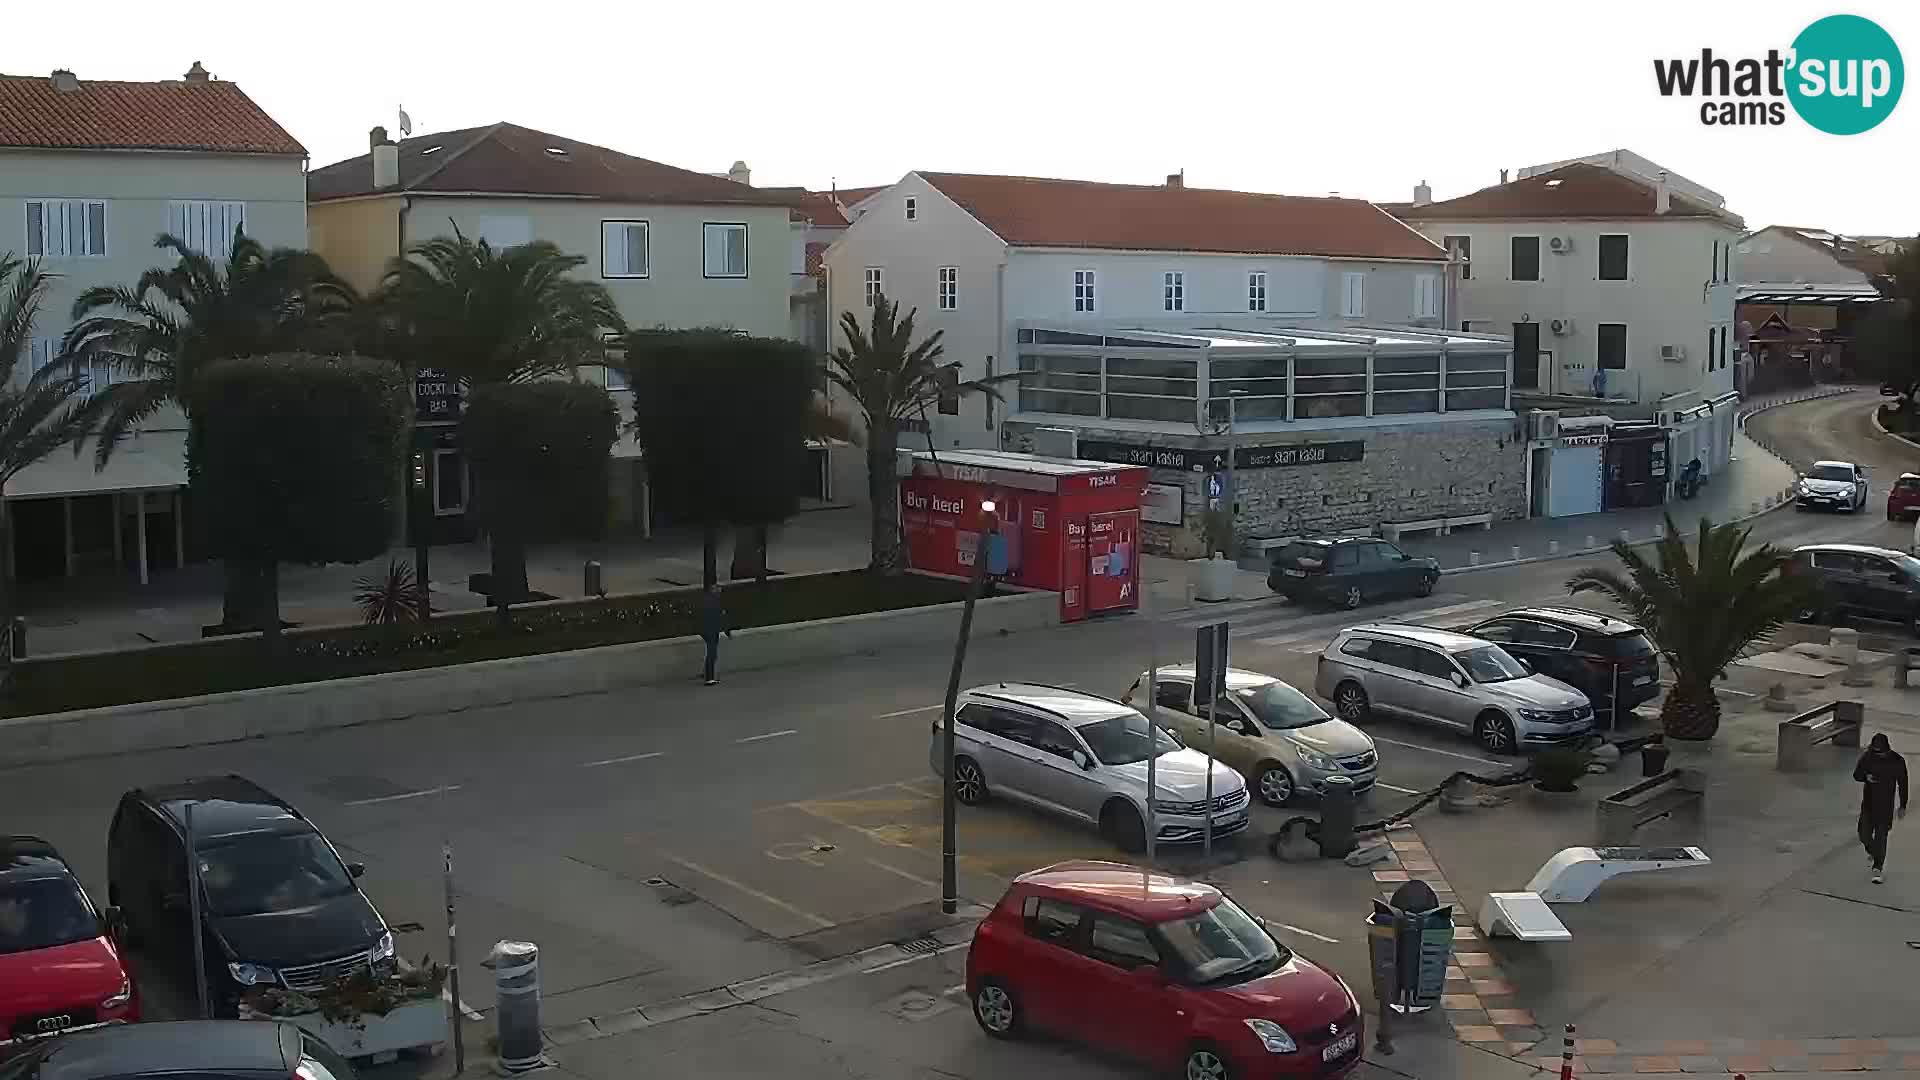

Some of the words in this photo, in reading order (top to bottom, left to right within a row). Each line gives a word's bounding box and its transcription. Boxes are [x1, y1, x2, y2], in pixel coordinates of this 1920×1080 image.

[418, 383, 460, 396] COCKTL
[1088, 475, 1117, 488] TISAK
[932, 495, 964, 515] here!
